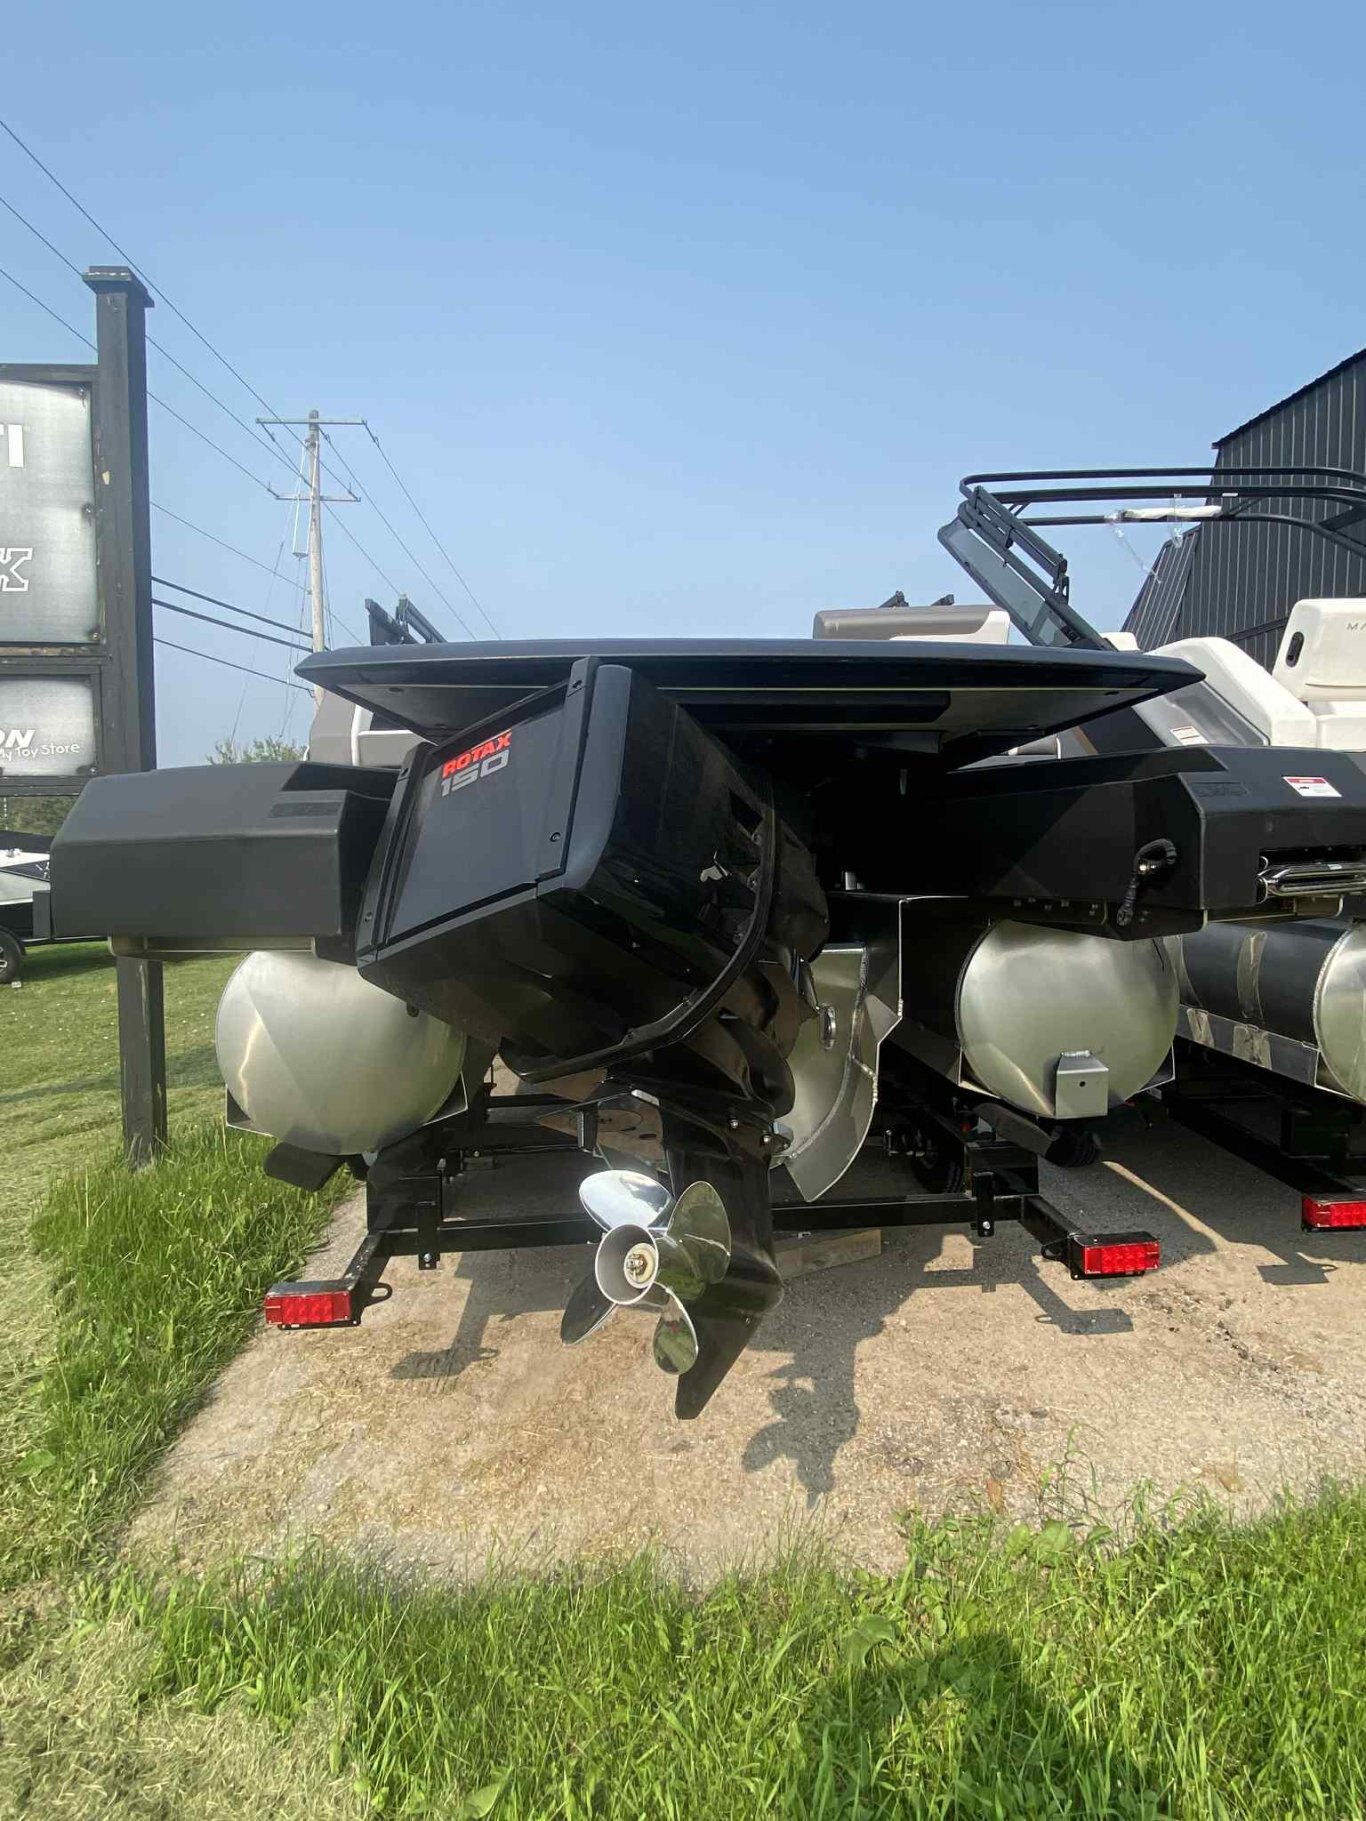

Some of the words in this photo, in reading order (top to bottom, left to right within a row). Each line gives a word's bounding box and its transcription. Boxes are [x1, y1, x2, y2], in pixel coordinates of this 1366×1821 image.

[0, 424, 24, 467] I
[0, 729, 35, 748] N
[15, 746, 38, 758] Toy
[40, 742, 80, 755] Store
[442, 731, 512, 778] ROTAX
[441, 749, 510, 797] 150
